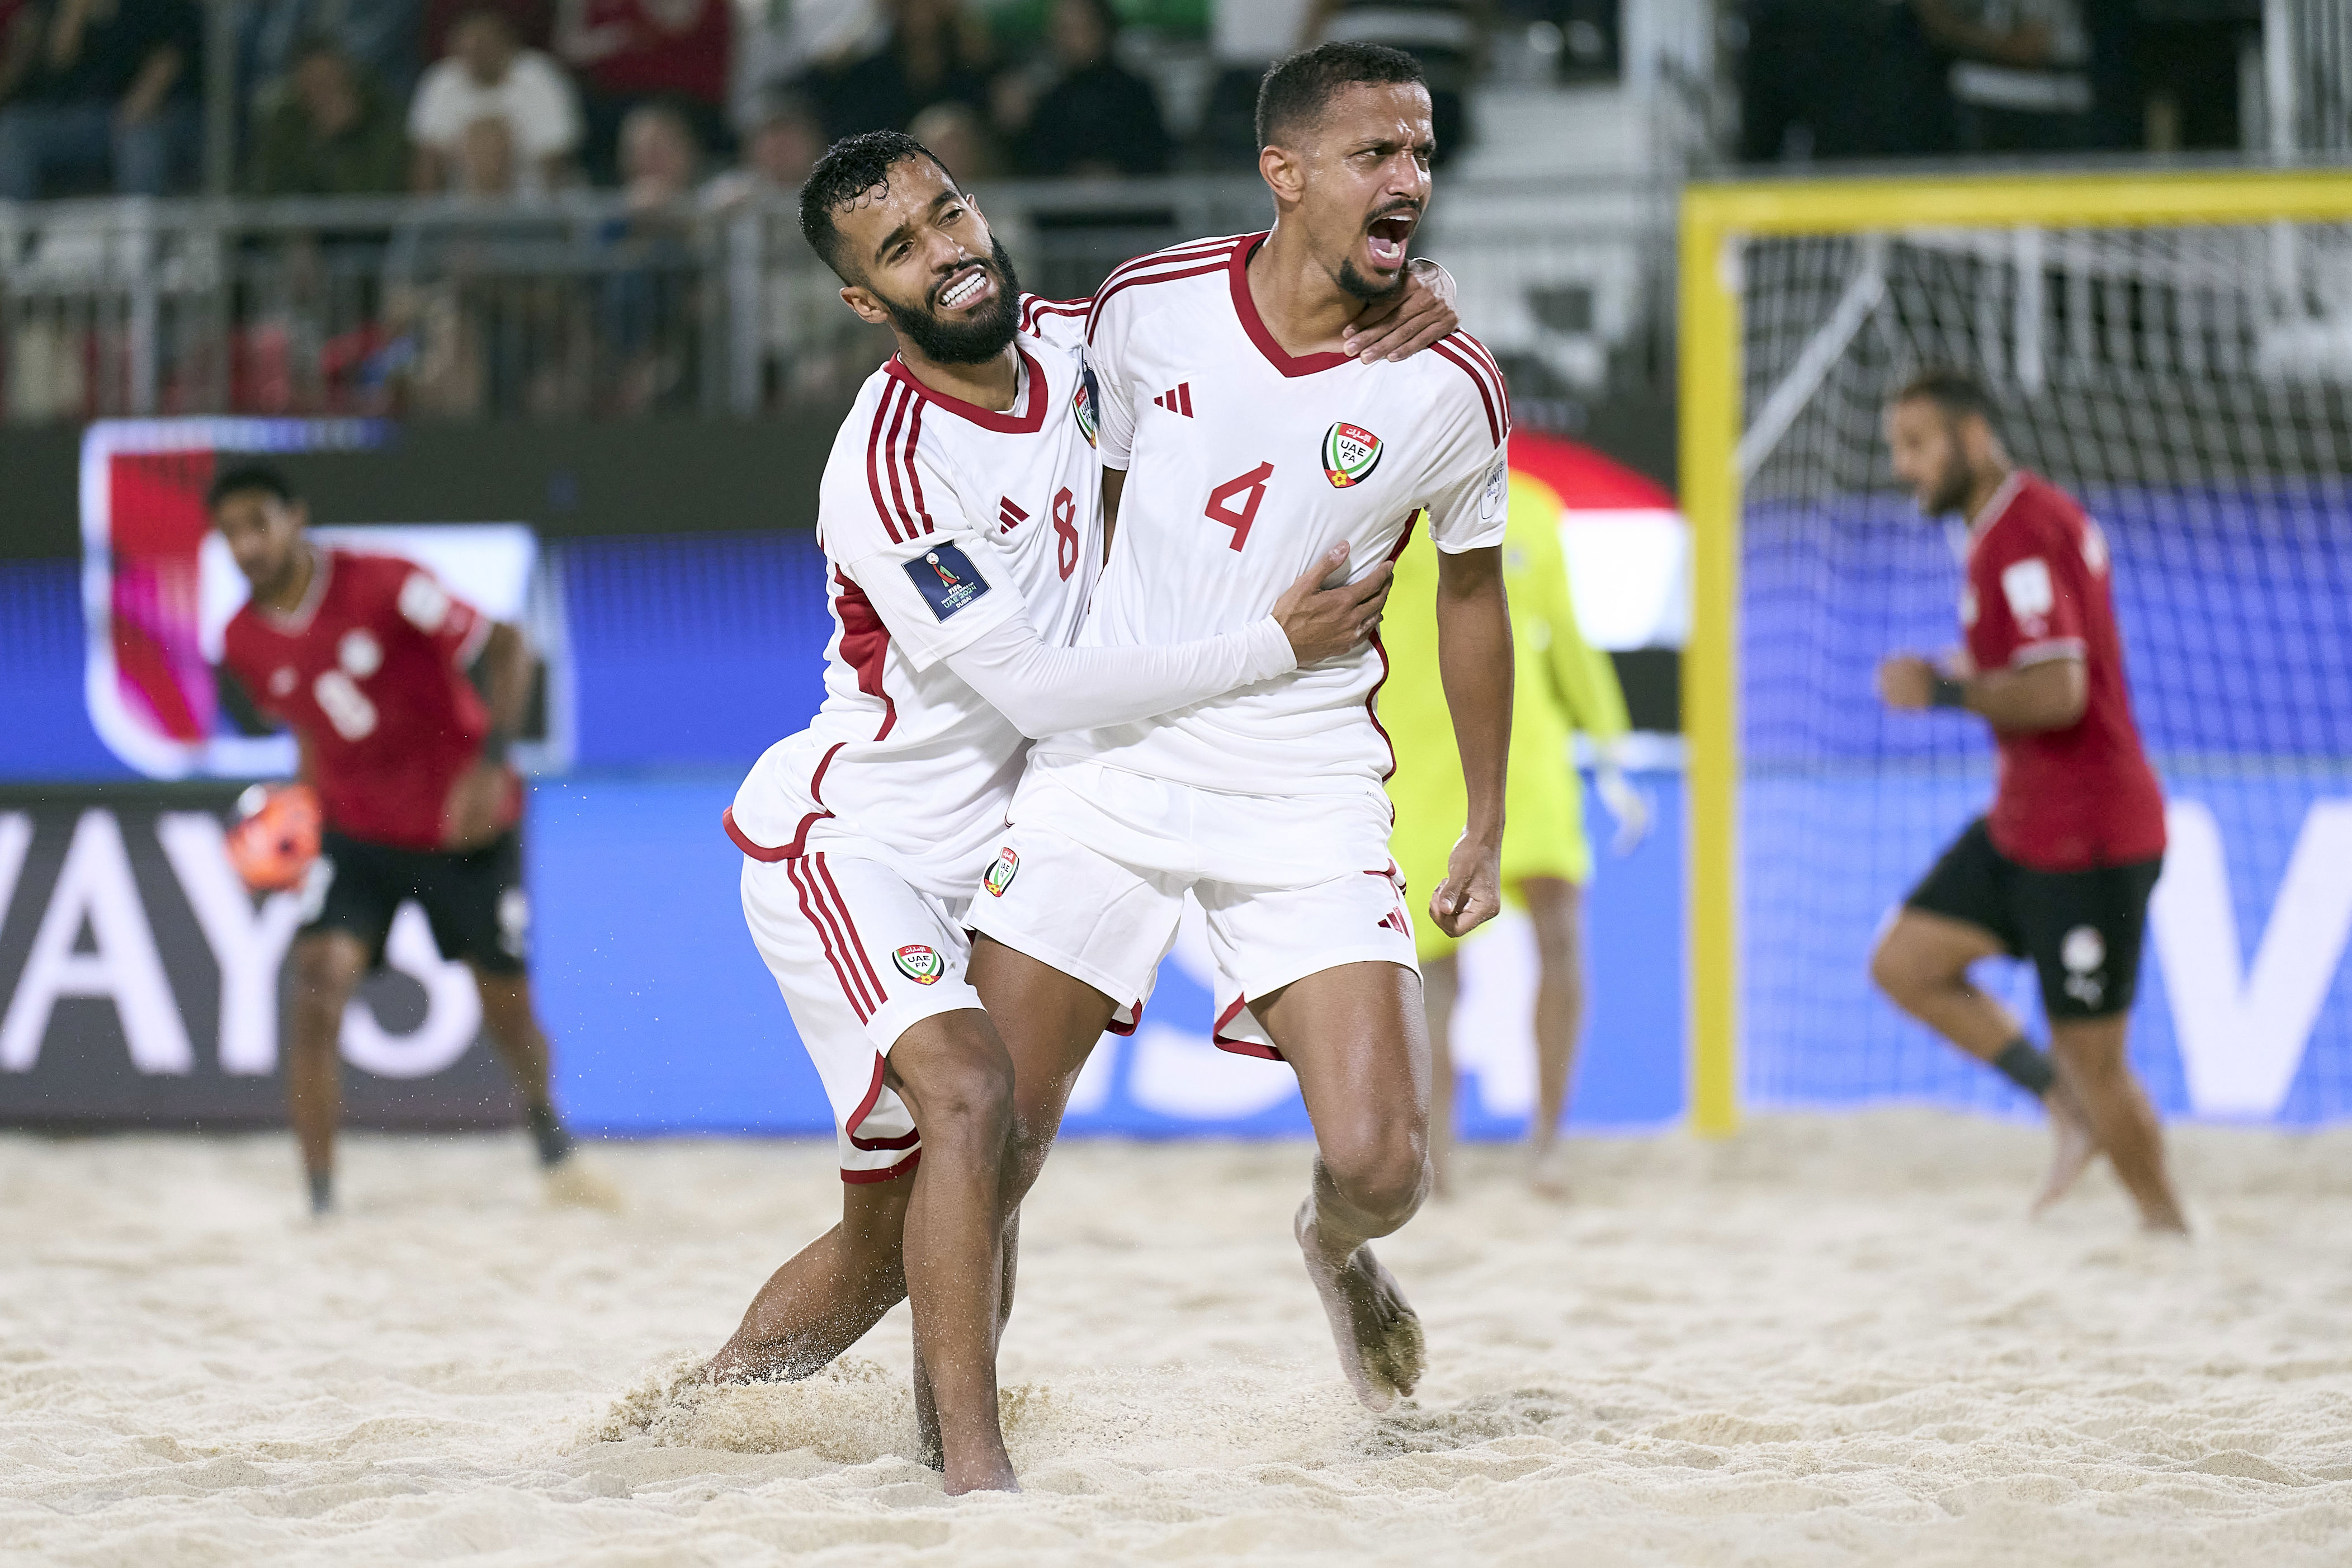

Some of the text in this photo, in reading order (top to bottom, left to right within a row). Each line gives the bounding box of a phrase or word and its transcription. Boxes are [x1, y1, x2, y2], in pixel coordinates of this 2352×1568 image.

[1340, 440, 1366, 457] UAE
[1342, 451, 1356, 463] FA
[1204, 460, 1275, 553] 4
[1052, 486, 1079, 583] 8
[943, 584, 977, 608] UAE 2024
[947, 583, 962, 596] FIFA
[955, 595, 972, 608] DUBAI
[0, 805, 485, 1079] AYS
